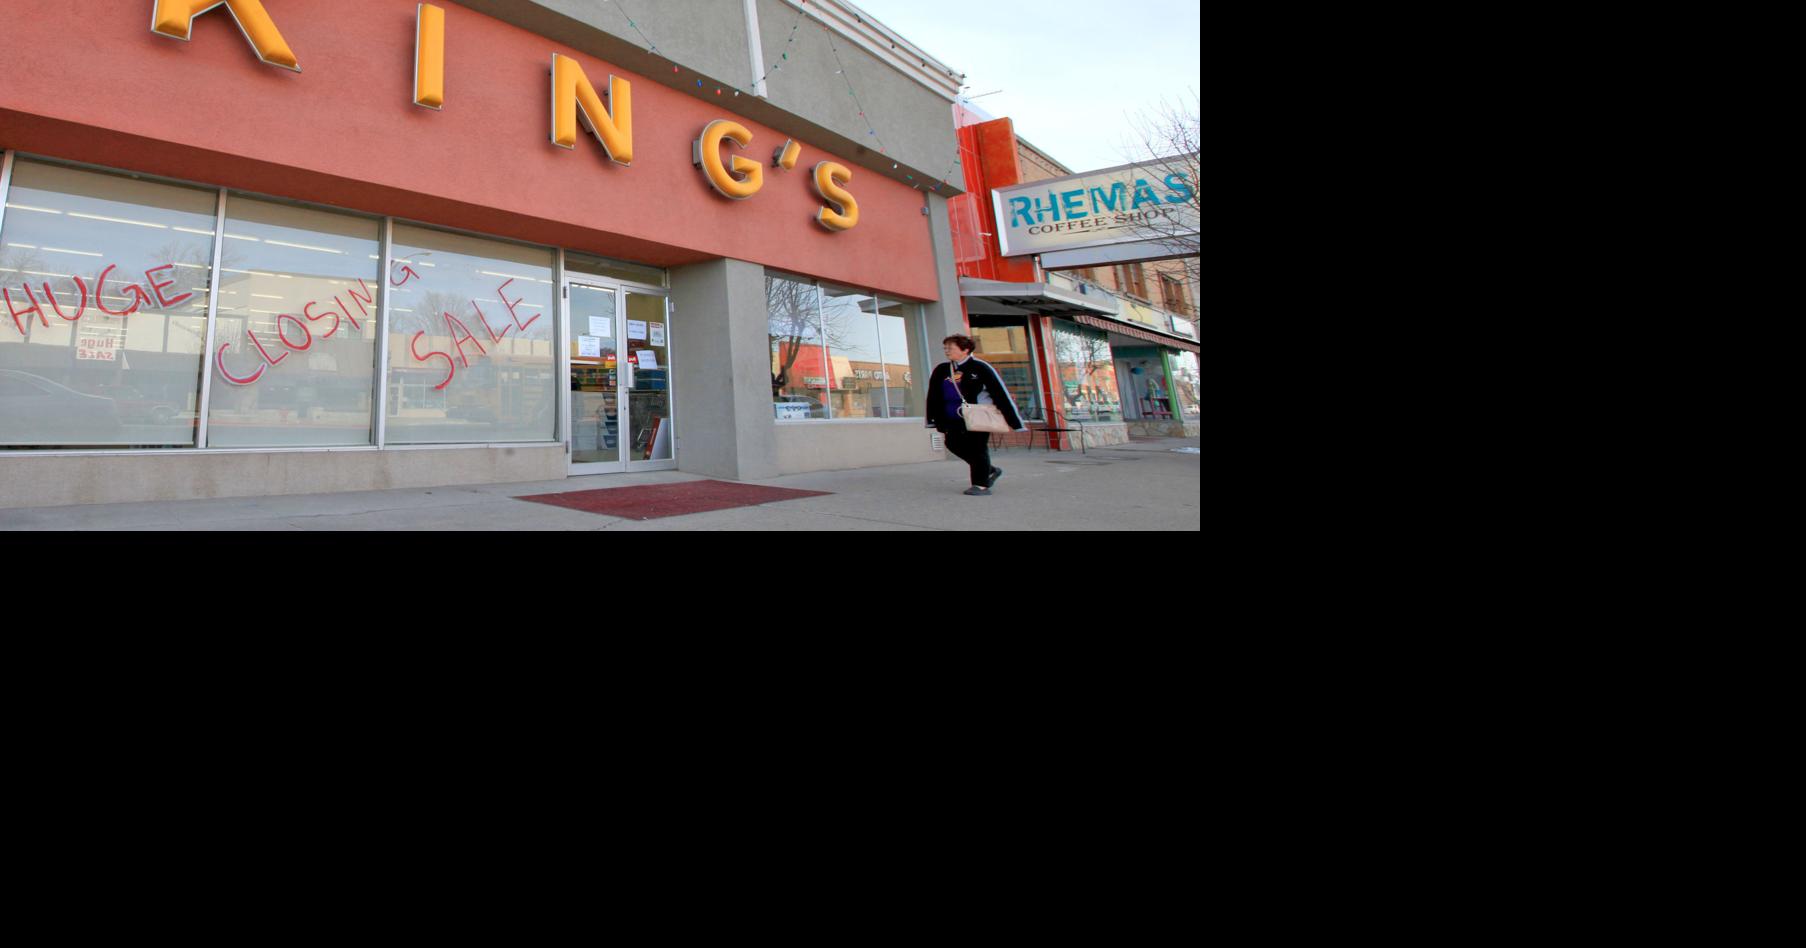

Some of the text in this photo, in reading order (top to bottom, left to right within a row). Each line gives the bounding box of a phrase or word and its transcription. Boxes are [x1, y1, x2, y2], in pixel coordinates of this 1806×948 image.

[1008, 172, 1193, 228] RHEMAS
[1028, 207, 1175, 236] COFFEE SHOP
[3, 263, 192, 335] HUGE
[217, 253, 431, 385] CLOSING
[410, 277, 541, 391] SALE
